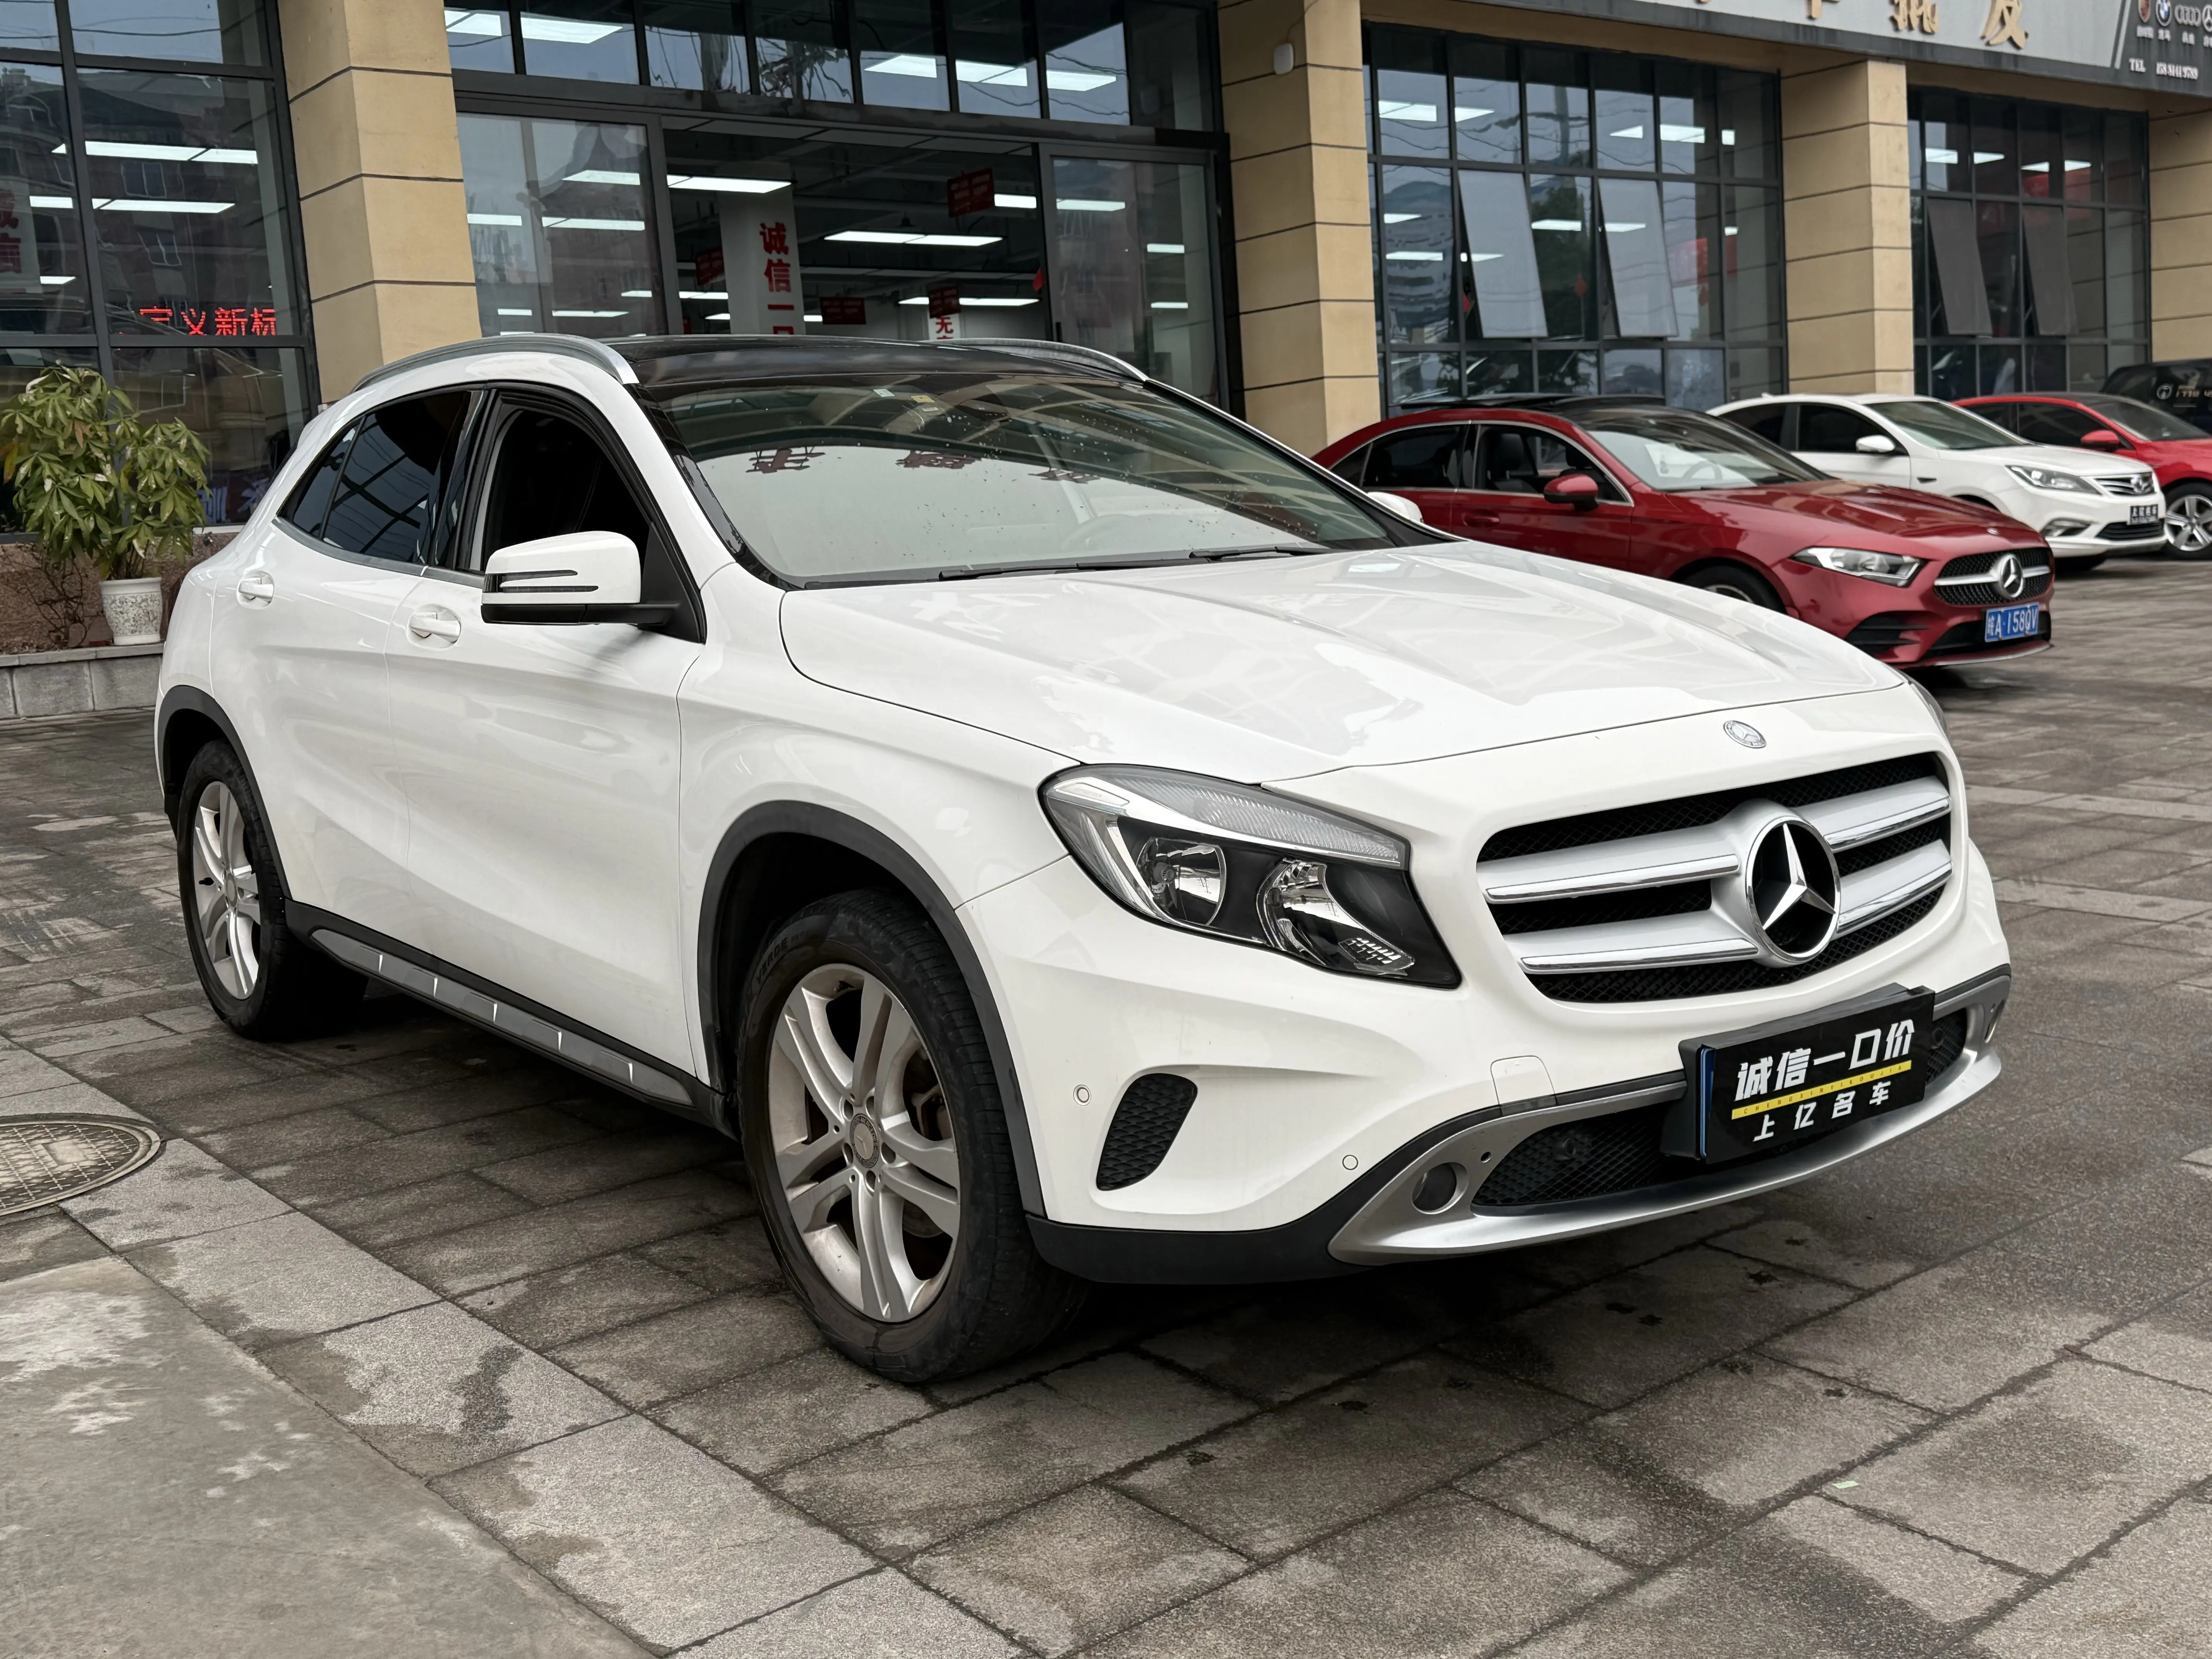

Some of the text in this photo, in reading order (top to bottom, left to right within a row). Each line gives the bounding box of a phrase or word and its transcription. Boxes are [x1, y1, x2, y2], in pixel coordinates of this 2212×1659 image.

[1735, 1019, 1915, 1101] 诚信一口价
[1753, 1081, 1891, 1142] 上亿名车
